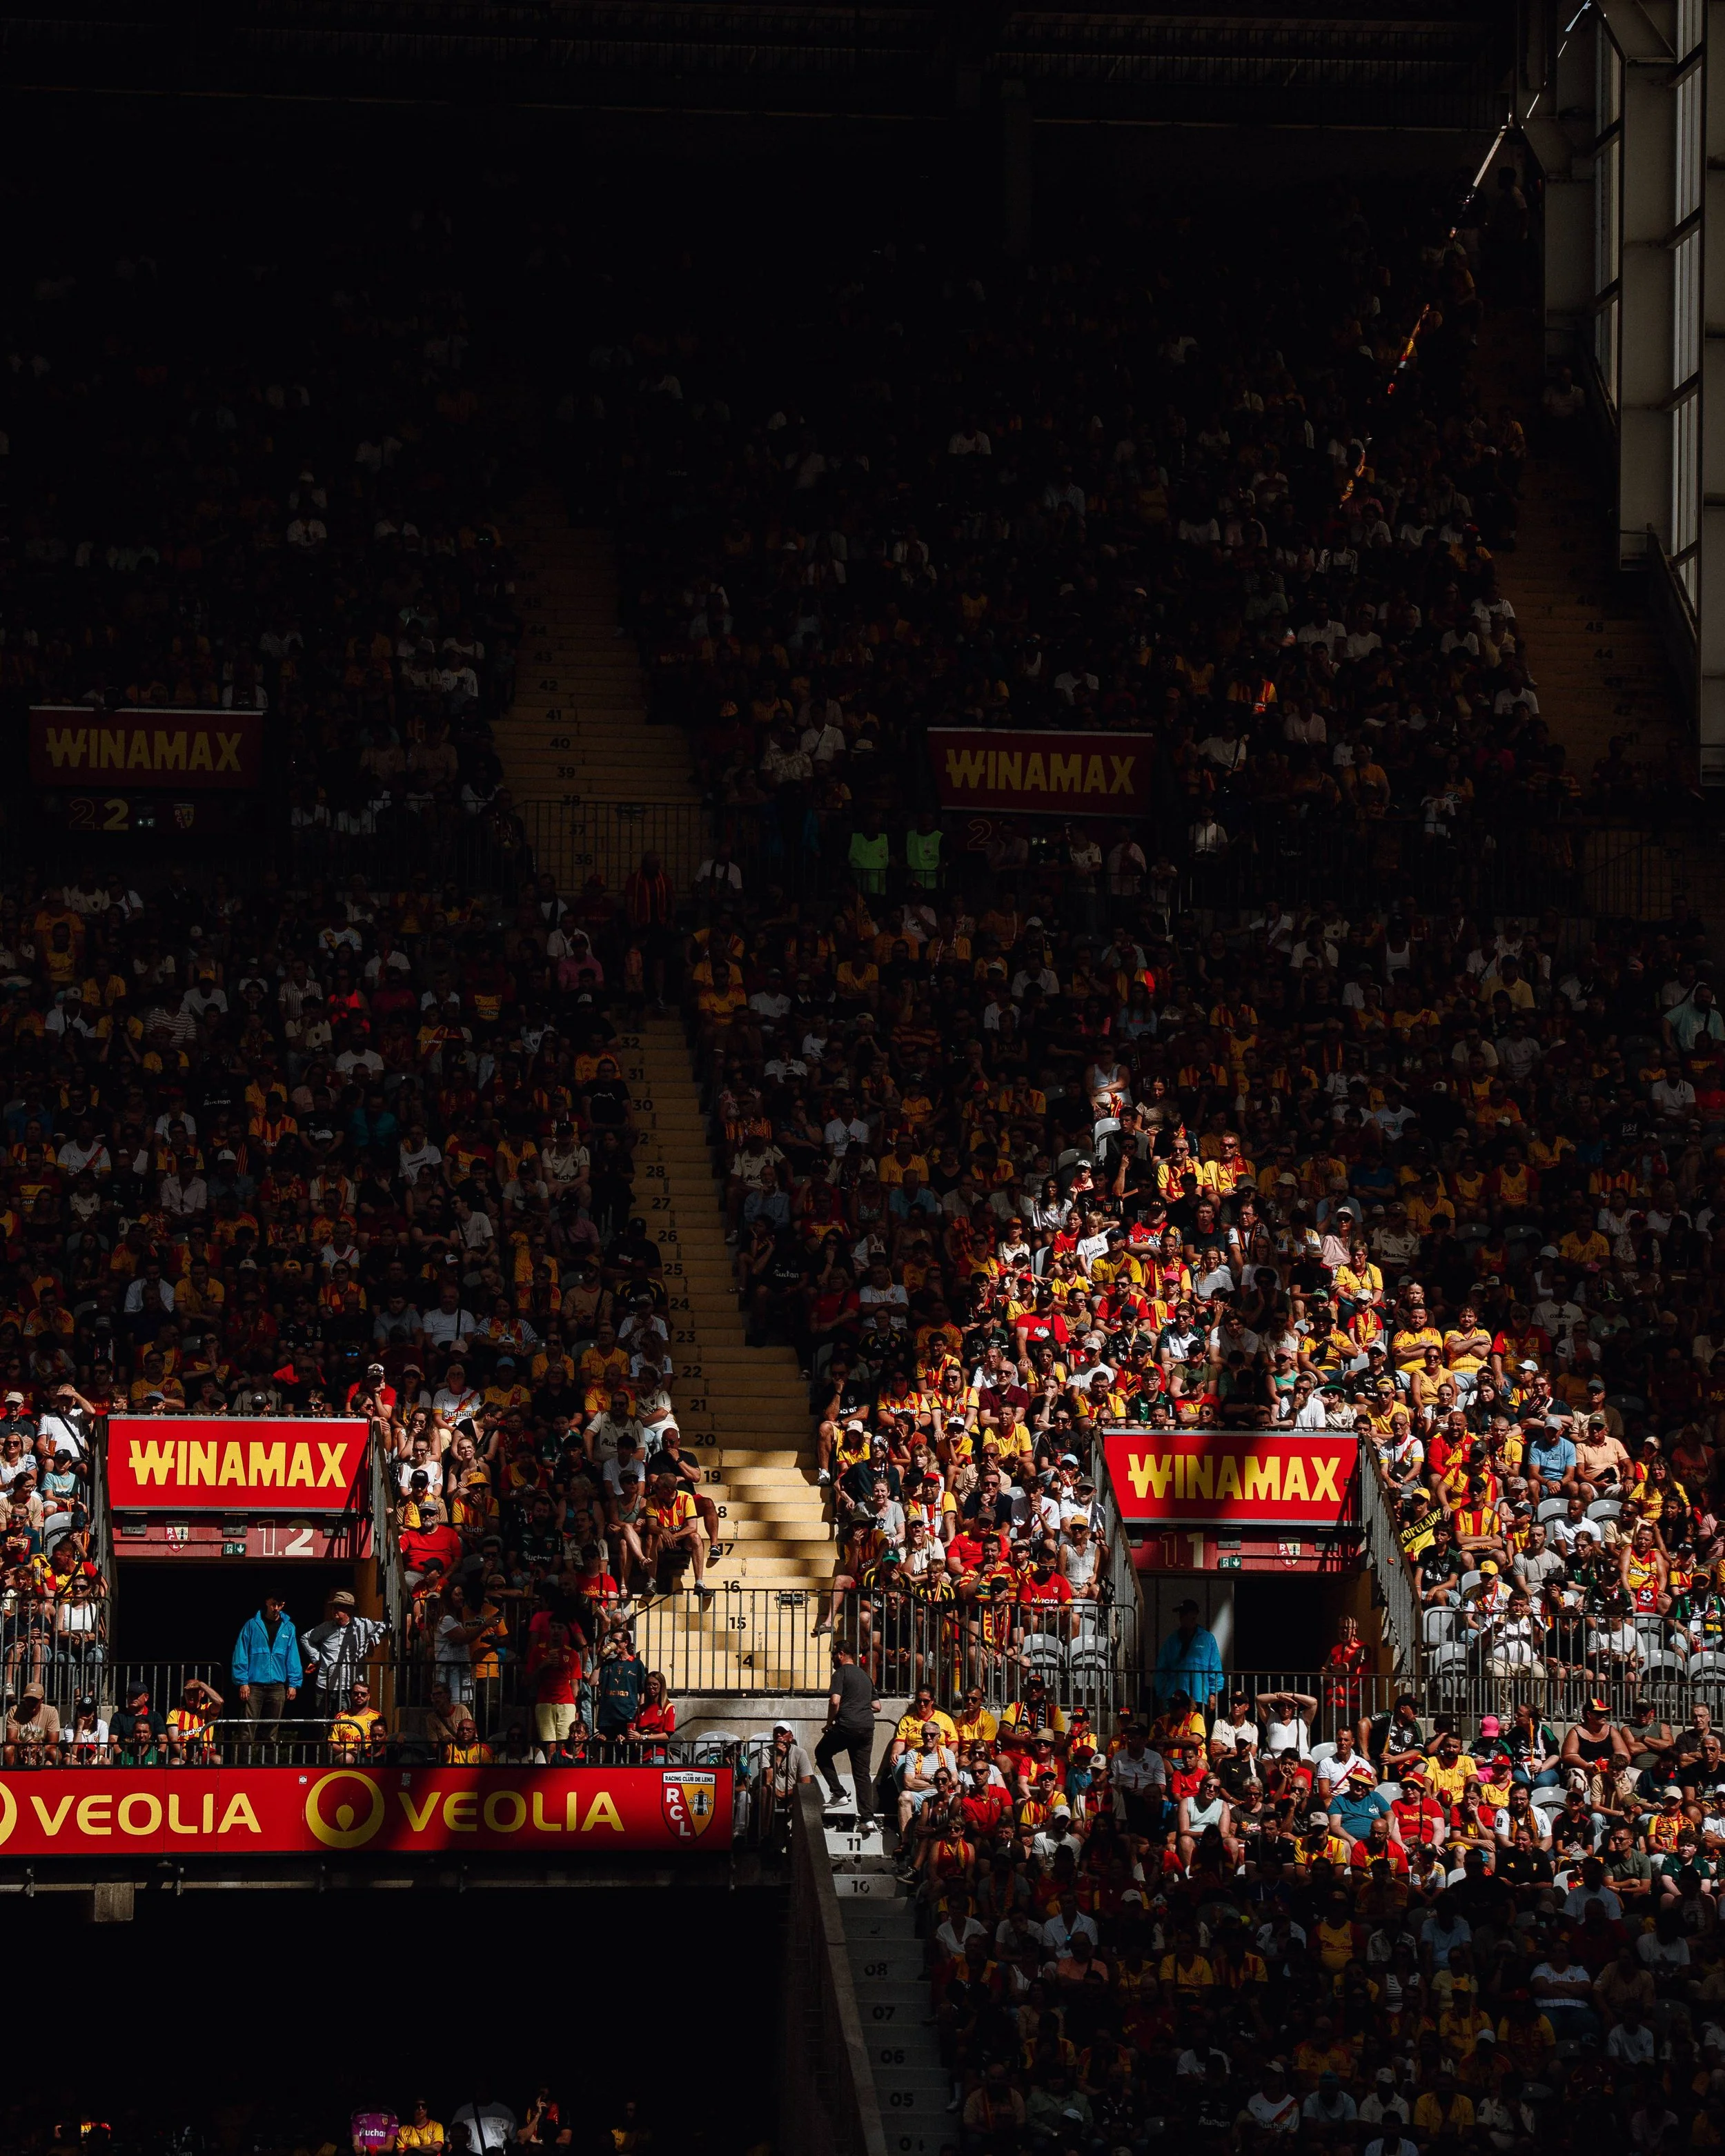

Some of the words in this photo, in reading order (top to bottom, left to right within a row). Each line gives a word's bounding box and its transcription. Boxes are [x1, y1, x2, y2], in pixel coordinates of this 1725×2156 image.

[1586, 622, 1604, 633] 45
[540, 680, 559, 691] 42
[546, 709, 562, 720] 41
[46, 727, 241, 771] WINAMAX
[550, 738, 571, 749] 40
[557, 767, 575, 778] 39
[945, 748, 1136, 795] WINAMAX
[621, 1037, 640, 1049] 32
[629, 1068, 644, 1080] 31
[633, 1099, 653, 1111] 30
[647, 1165, 664, 1178] 28
[651, 1198, 671, 1209] 27
[658, 1230, 678, 1242] 26
[664, 1263, 683, 1276] 25
[669, 1298, 690, 1309] 24
[676, 1331, 696, 1343] 23
[682, 1365, 702, 1378] 22
[690, 1399, 707, 1412] 21
[443, 1409, 472, 1418] Auchan
[695, 1434, 716, 1446] 20
[128, 1439, 348, 1487] WINAMAX
[704, 1470, 722, 1483] 19
[1127, 1454, 1341, 1501] WINAMAX
[257, 1519, 314, 1556] 1.2
[720, 1543, 735, 1556] 17
[522, 1550, 552, 1563] Auchan
[723, 1580, 740, 1593] 16
[729, 1616, 747, 1630] 15
[736, 1654, 753, 1668] 14
[30, 1792, 262, 1836] VEOLIA
[398, 1791, 625, 1832] VEOLIA
[847, 1838, 861, 1851] 11
[851, 1880, 870, 1893] 10
[872, 2006, 895, 2020] 07
[880, 2050, 905, 2064] 06
[889, 2093, 914, 2107] 05
[1198, 2115, 1231, 2128] Auchan
